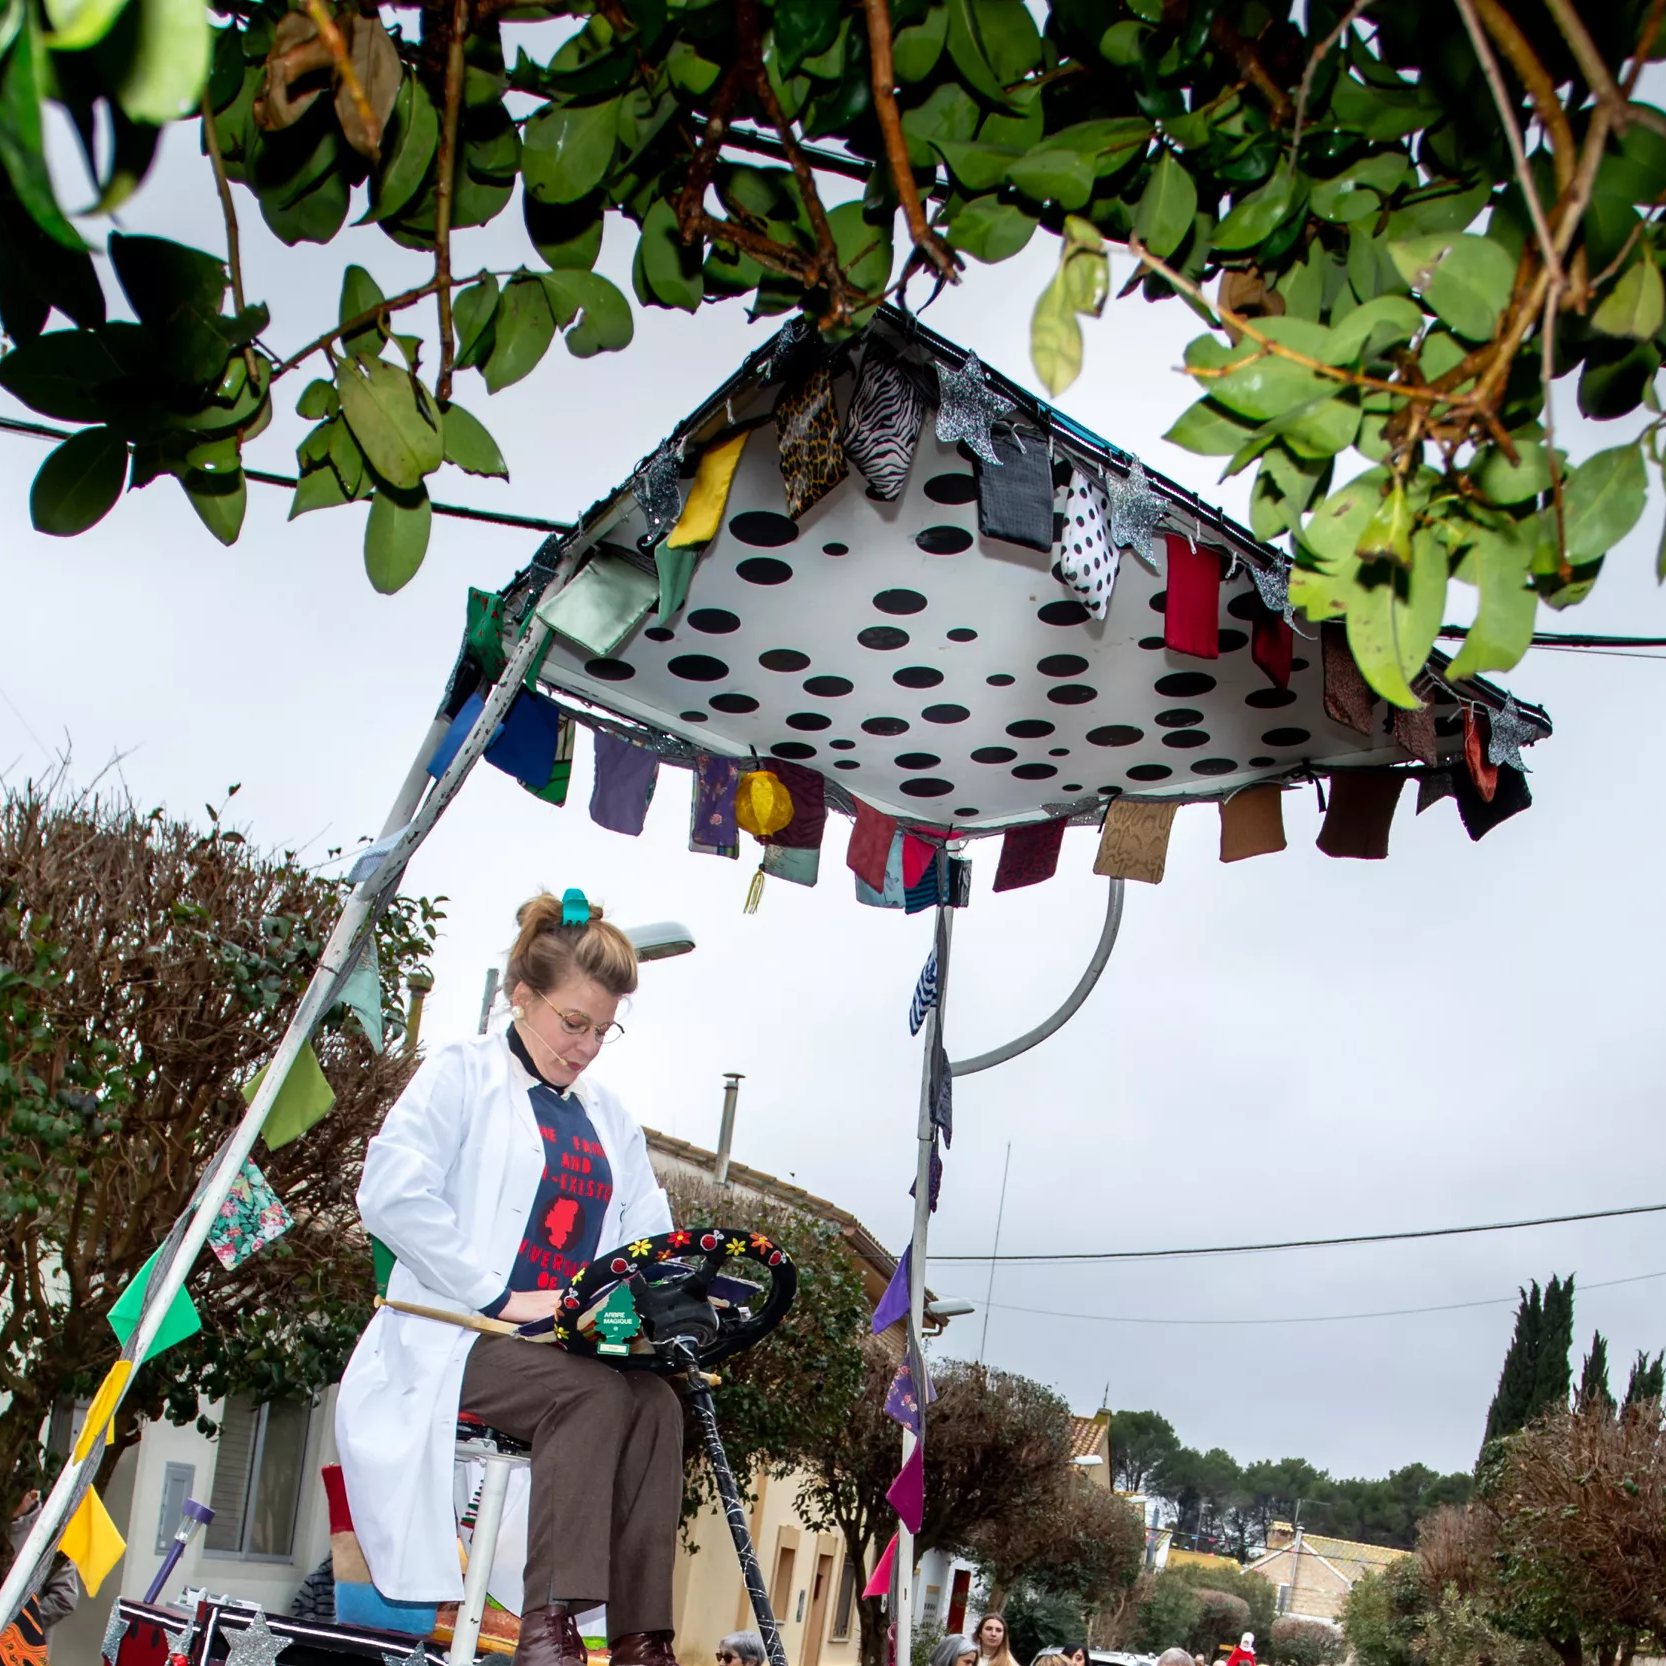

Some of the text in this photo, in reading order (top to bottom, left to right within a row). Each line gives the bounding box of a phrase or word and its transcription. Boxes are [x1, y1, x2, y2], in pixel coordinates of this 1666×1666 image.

[538, 1125, 557, 1143] HE
[561, 1152, 592, 1175] AND
[537, 1271, 558, 1290] OF
